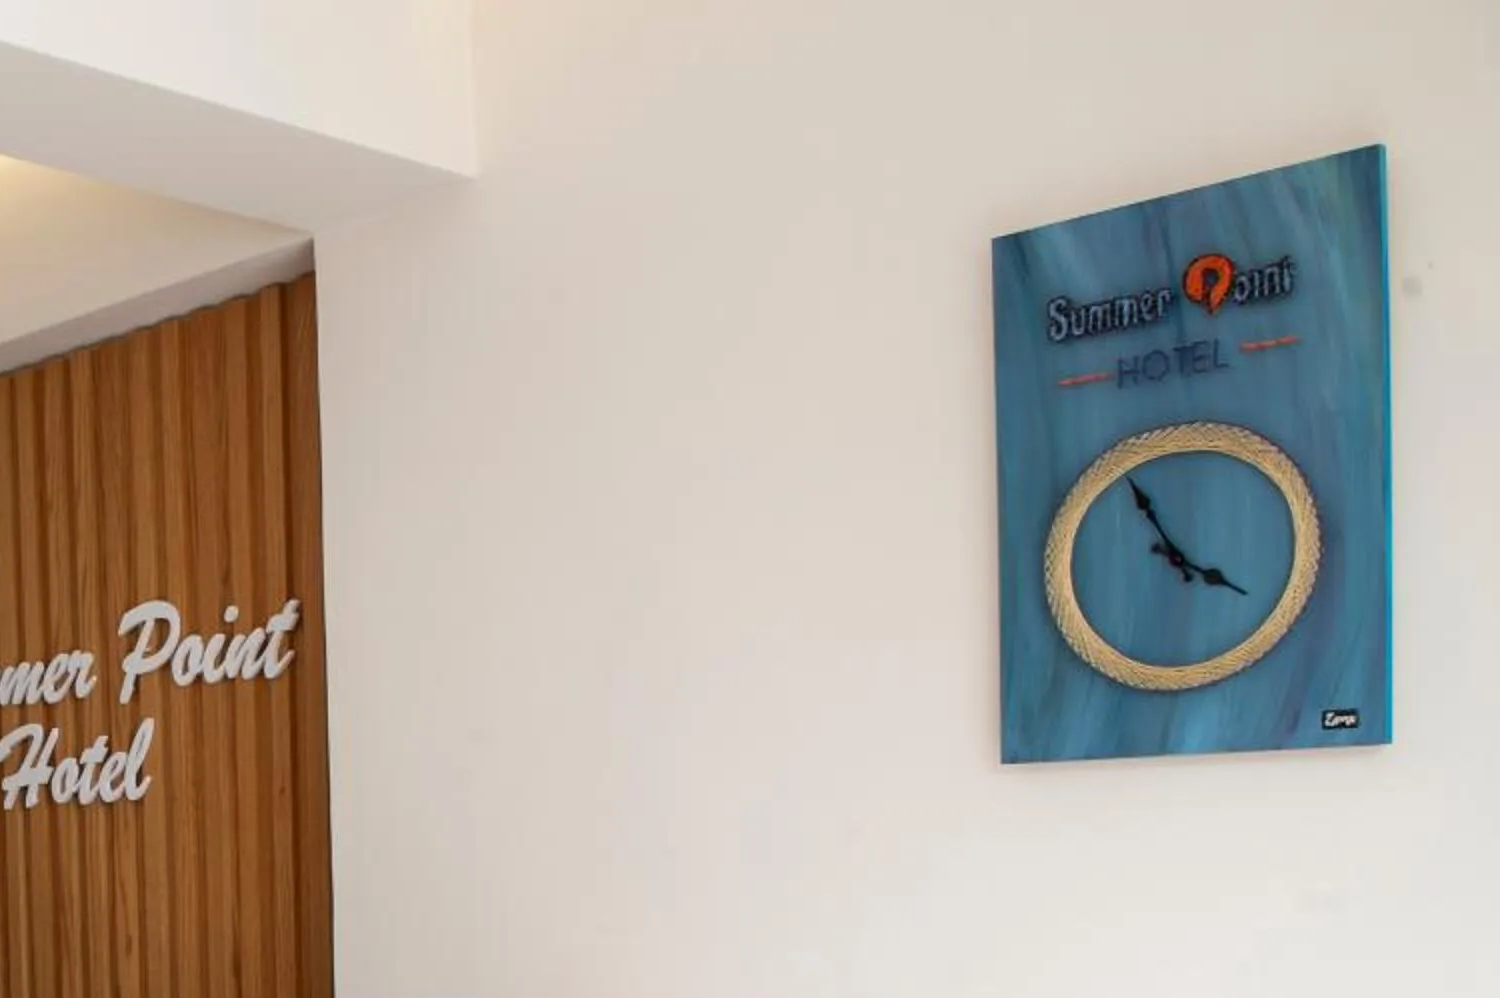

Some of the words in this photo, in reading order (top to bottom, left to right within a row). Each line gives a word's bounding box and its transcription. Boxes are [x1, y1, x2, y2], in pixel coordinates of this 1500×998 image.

[1047, 287, 1173, 343] Summer
[1116, 339, 1230, 390] HOTEL
[117, 599, 300, 705] Point
